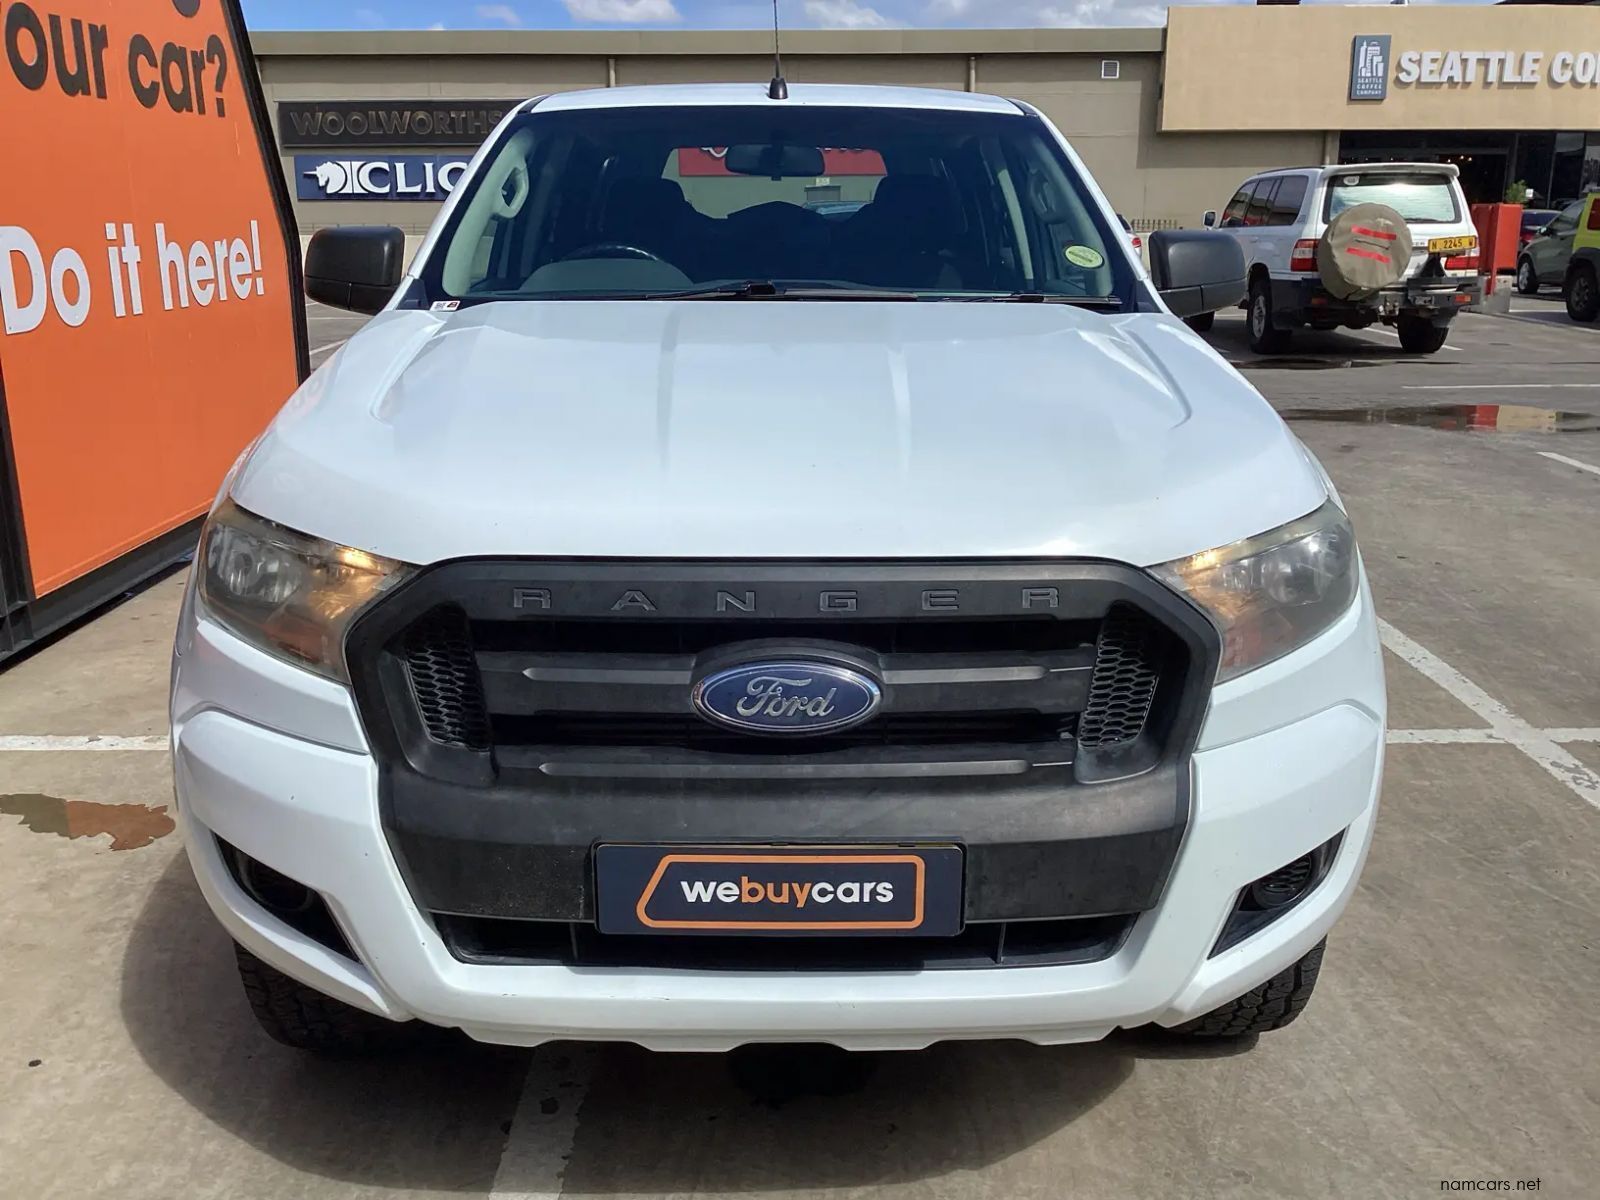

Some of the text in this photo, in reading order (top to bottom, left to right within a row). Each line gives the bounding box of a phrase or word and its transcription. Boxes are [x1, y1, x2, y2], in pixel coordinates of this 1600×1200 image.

[128, 34, 227, 117] car?
[1398, 51, 1600, 83] SEATTLE CO
[1431, 242, 1438, 250] N
[1443, 239, 1463, 249] 2245
[0, 220, 265, 335] Do it here!
[512, 587, 1062, 612] RANGER
[736, 676, 836, 718] Ford
[680, 876, 894, 908] webuycars
